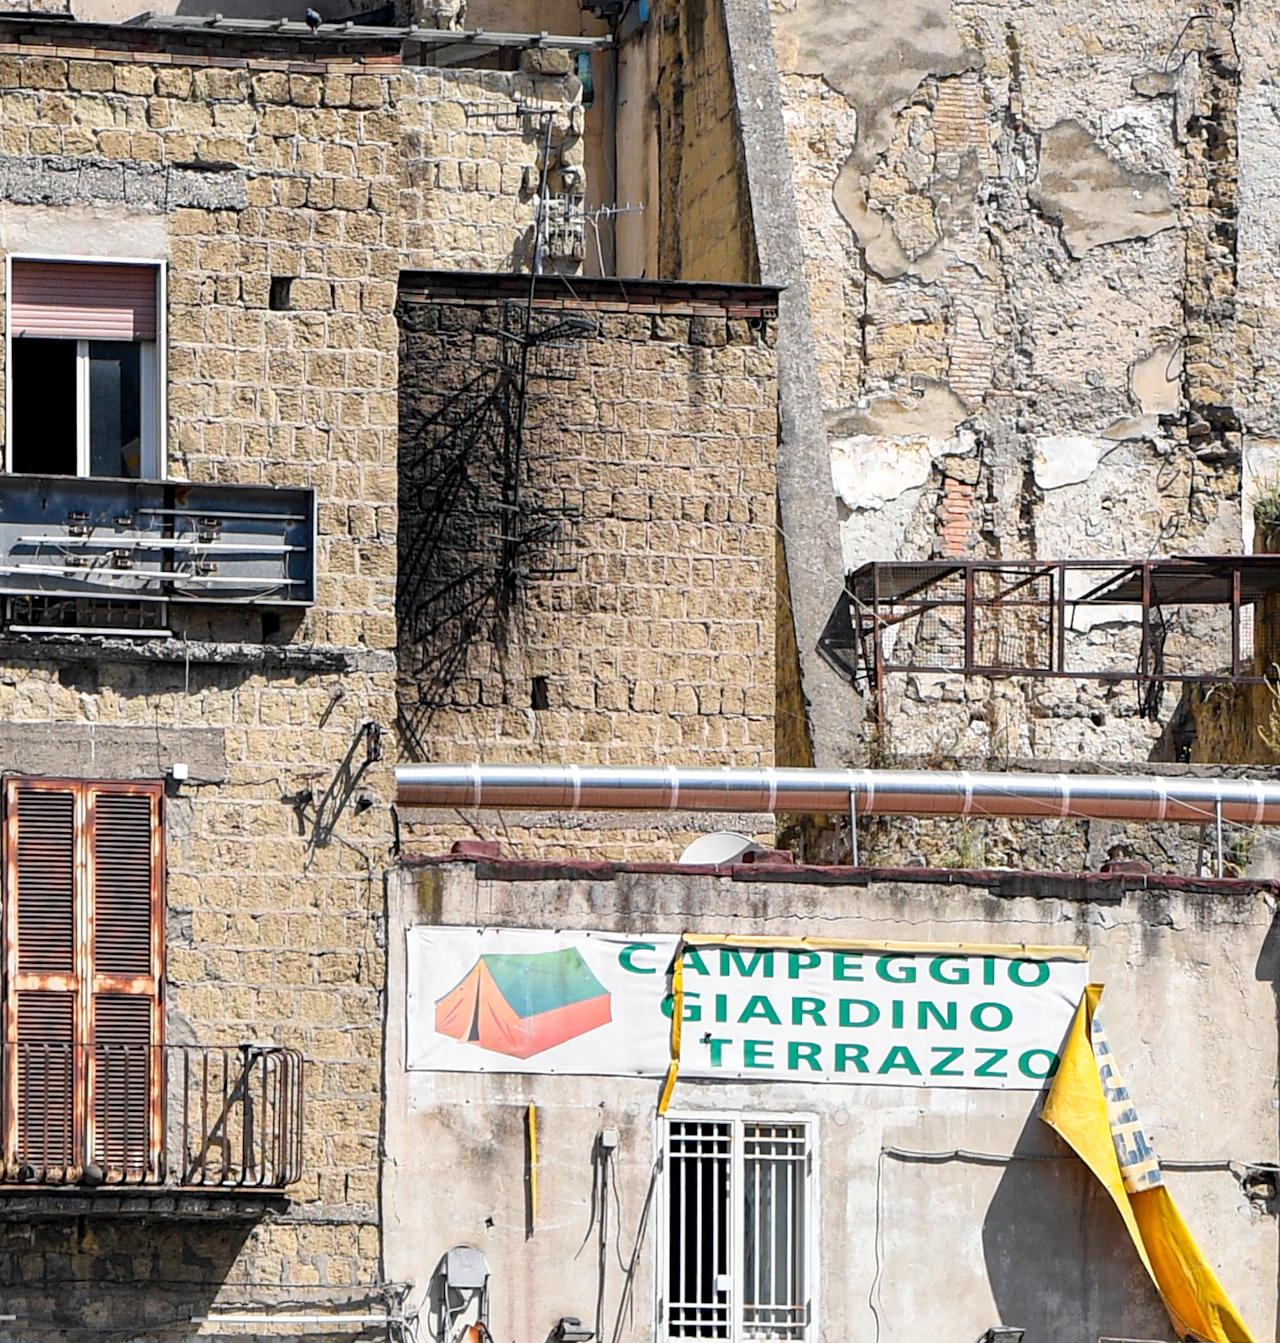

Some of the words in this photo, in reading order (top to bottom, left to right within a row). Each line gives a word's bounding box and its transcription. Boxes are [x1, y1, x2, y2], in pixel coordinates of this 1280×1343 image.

[618, 943, 1051, 988] CAMPEGGIO
[660, 990, 1014, 1032] GIARDINO
[699, 1037, 1061, 1080] TERRAZZO
